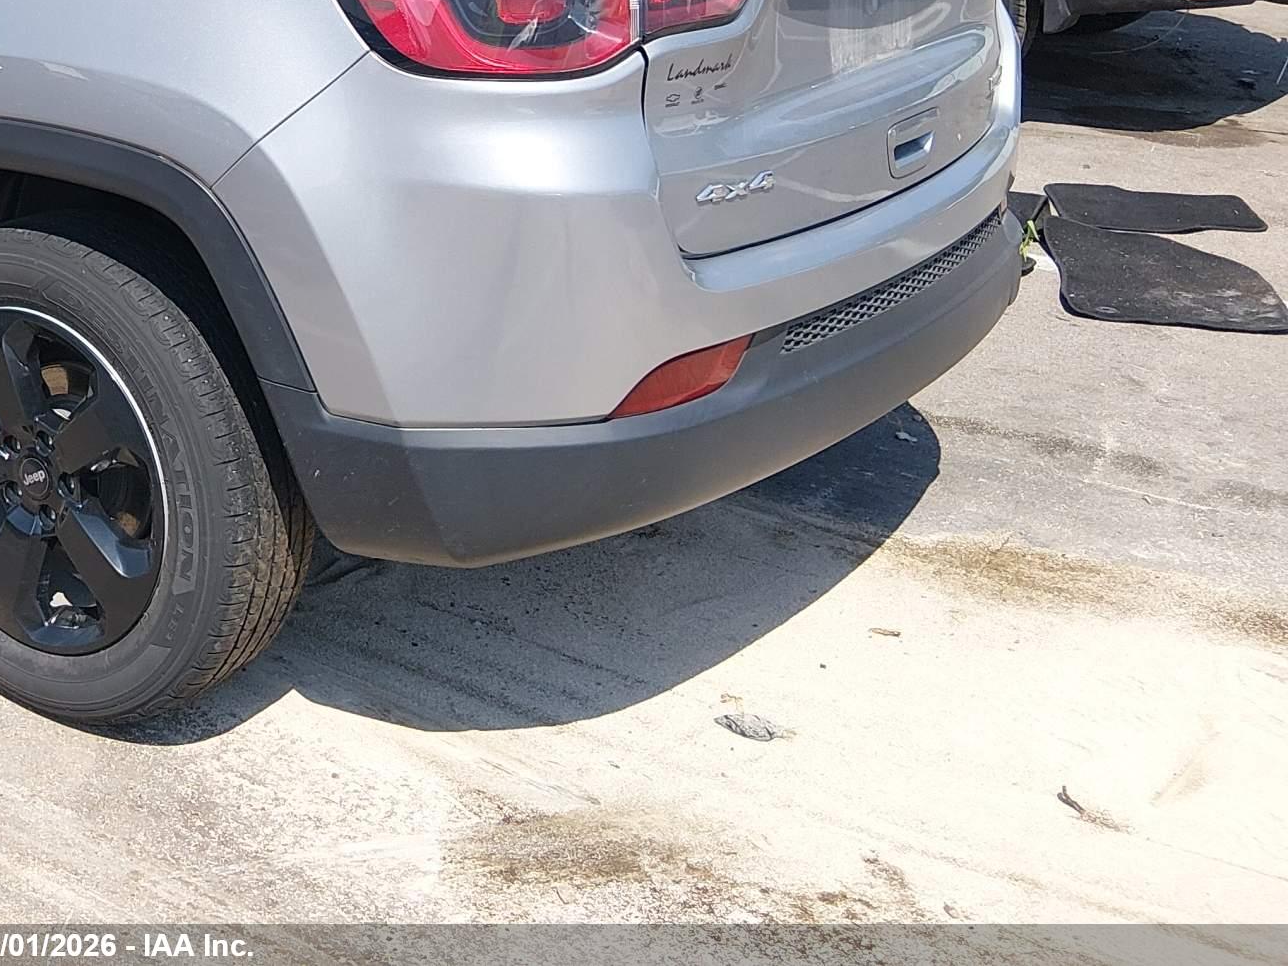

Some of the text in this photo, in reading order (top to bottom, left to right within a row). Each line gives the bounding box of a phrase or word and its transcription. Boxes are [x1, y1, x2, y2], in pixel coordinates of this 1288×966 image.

[666, 53, 732, 82] Landmark
[52, 282, 196, 583] DESTINATION
[23, 469, 45, 486] Jeep
